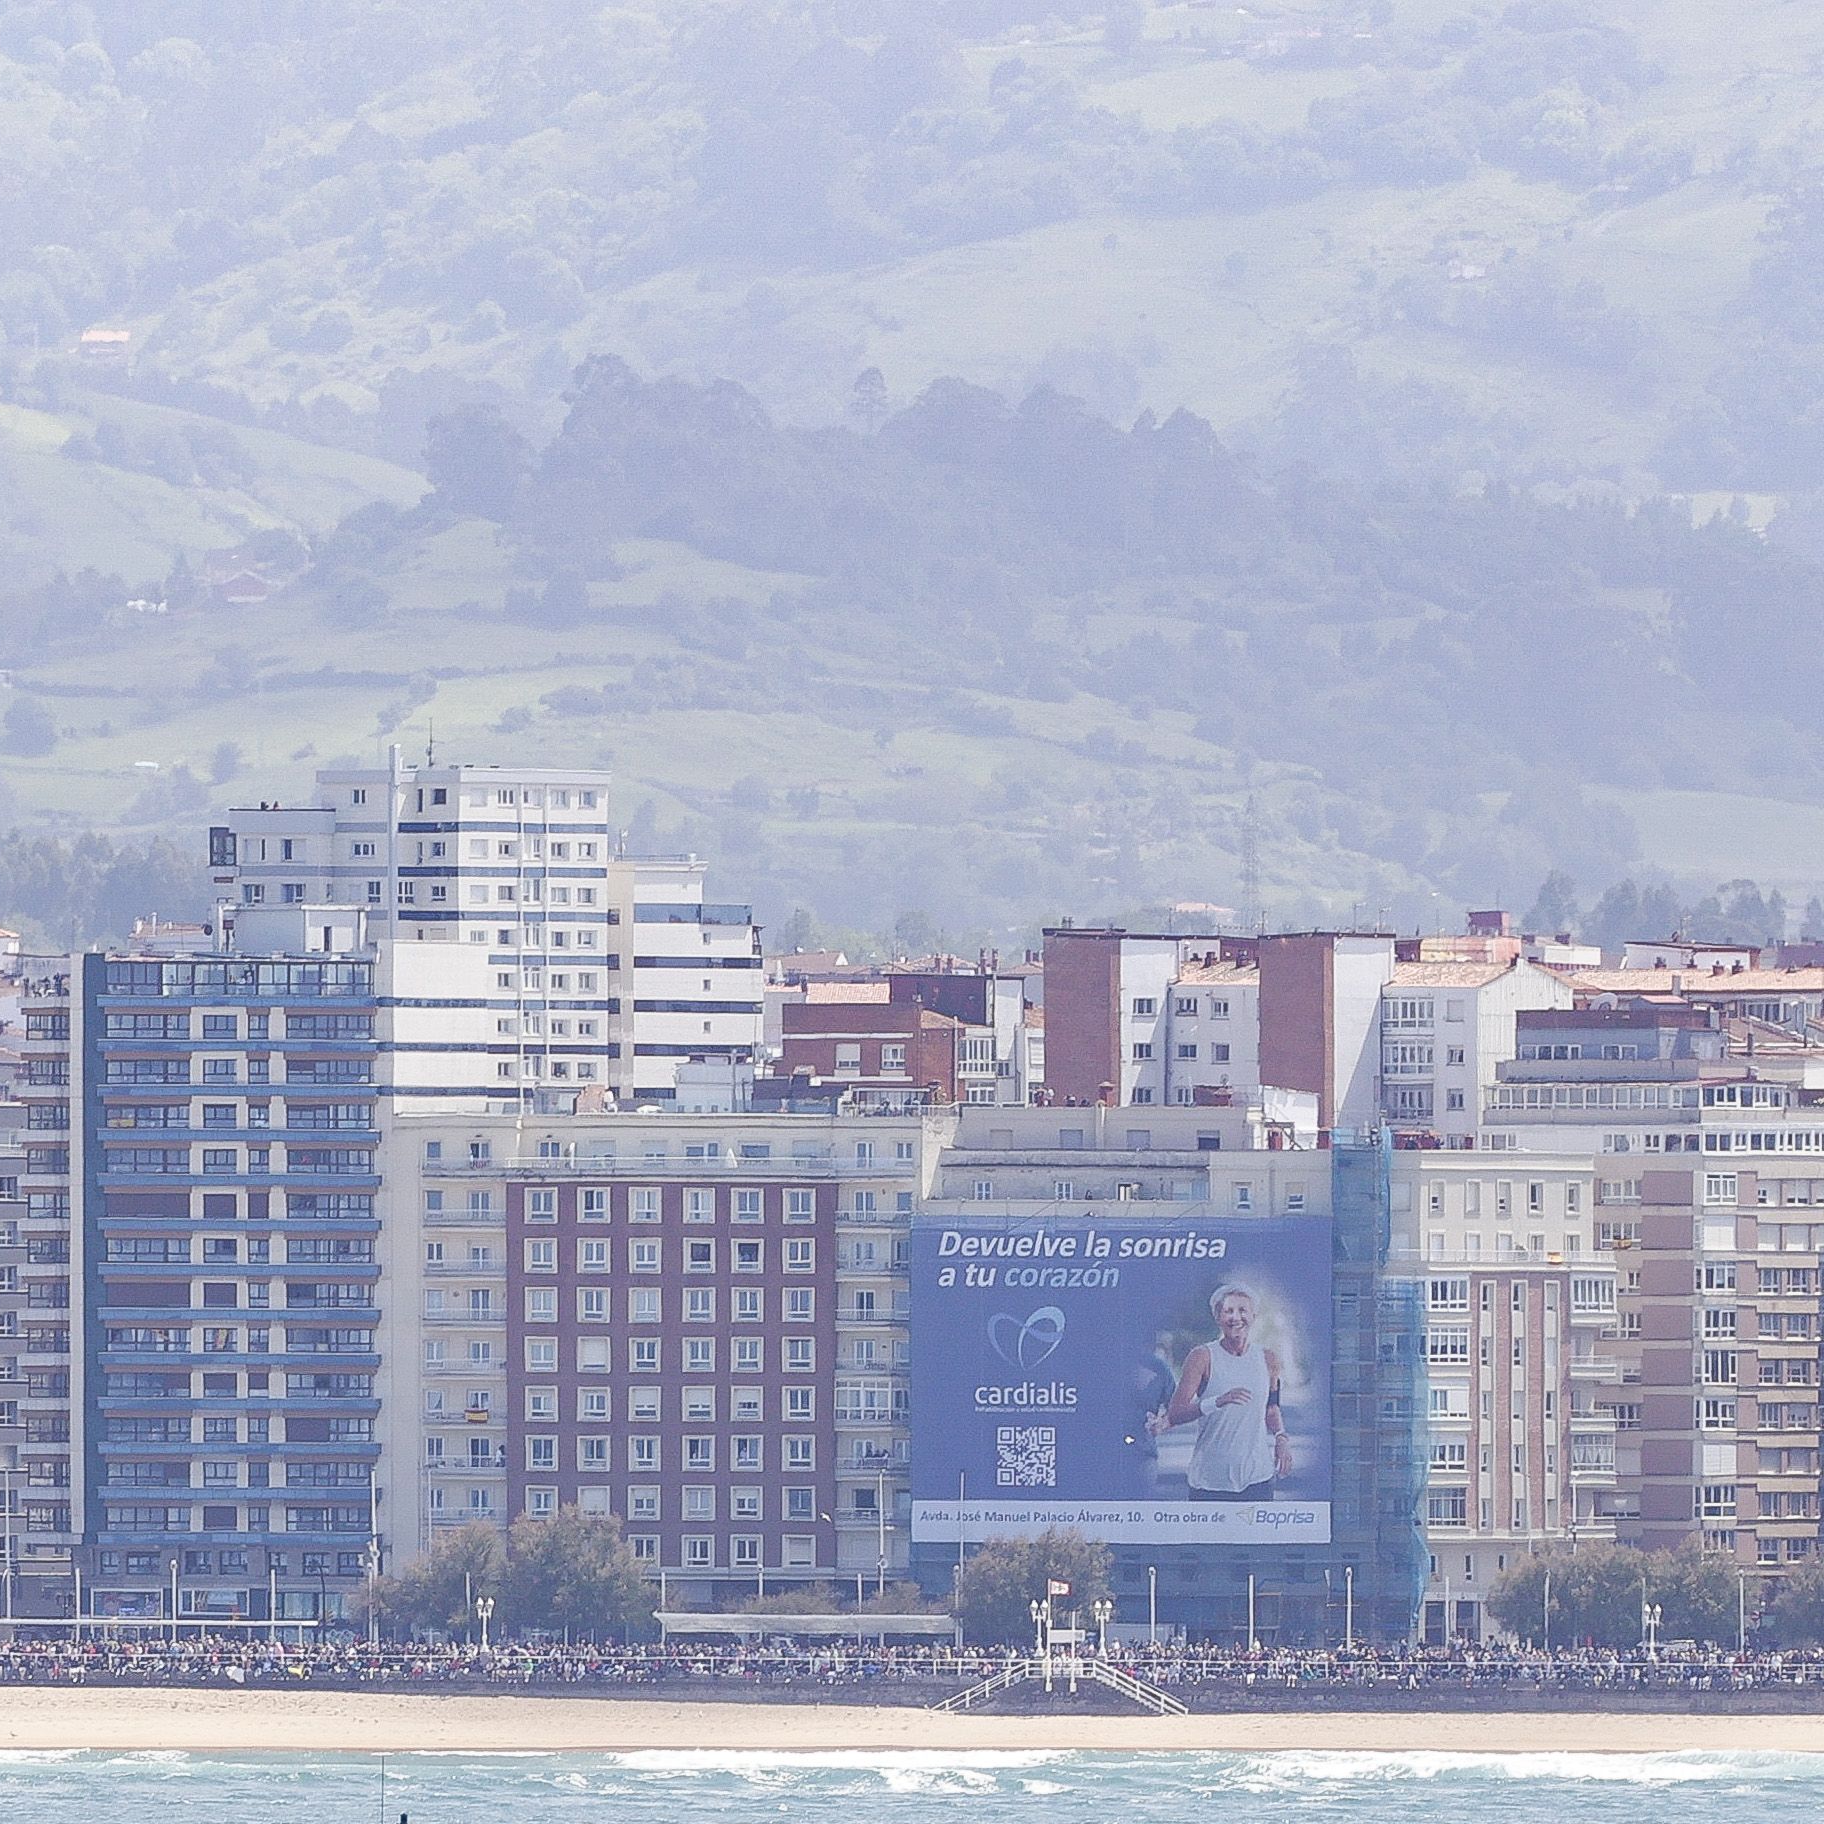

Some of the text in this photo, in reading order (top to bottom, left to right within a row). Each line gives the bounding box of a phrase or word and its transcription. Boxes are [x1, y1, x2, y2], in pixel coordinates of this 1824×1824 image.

[938, 1230, 1227, 1258] Devuelve la sonrisa
[938, 1261, 1120, 1288] a tu corazón
[974, 1381, 1078, 1405] cardialis
[920, 1508, 1144, 1525] Avda. José Manuel Palacio Álvarez, 10.
[1153, 1511, 1226, 1523] Otra obra de
[1255, 1508, 1315, 1529] Boprisa
